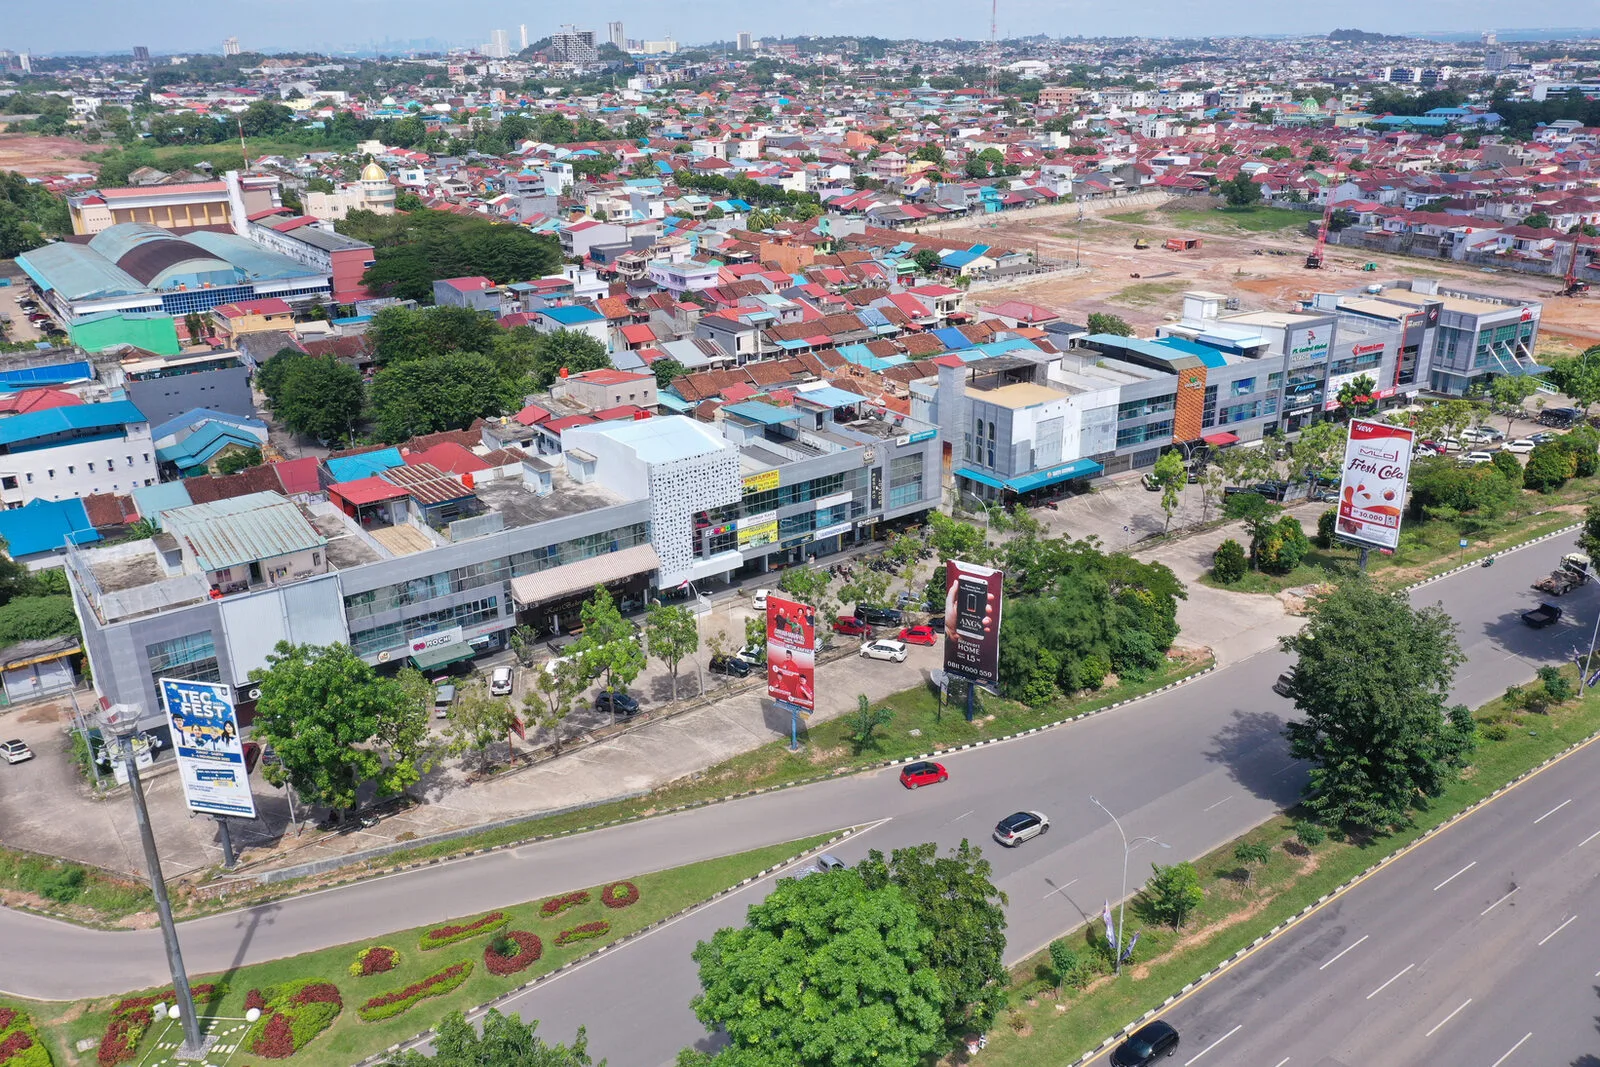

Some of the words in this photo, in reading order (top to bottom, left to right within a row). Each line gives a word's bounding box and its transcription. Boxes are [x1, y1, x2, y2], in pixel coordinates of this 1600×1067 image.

[1355, 424, 1374, 433] NEW
[1348, 458, 1377, 475] Fresh
[1378, 465, 1404, 480] Cola
[426, 635, 451, 648] MOCHI
[957, 643, 981, 656] HOME
[947, 661, 960, 669] 0811
[961, 665, 978, 674] 7000
[178, 689, 212, 705] TEC
[181, 702, 226, 719] FEST
